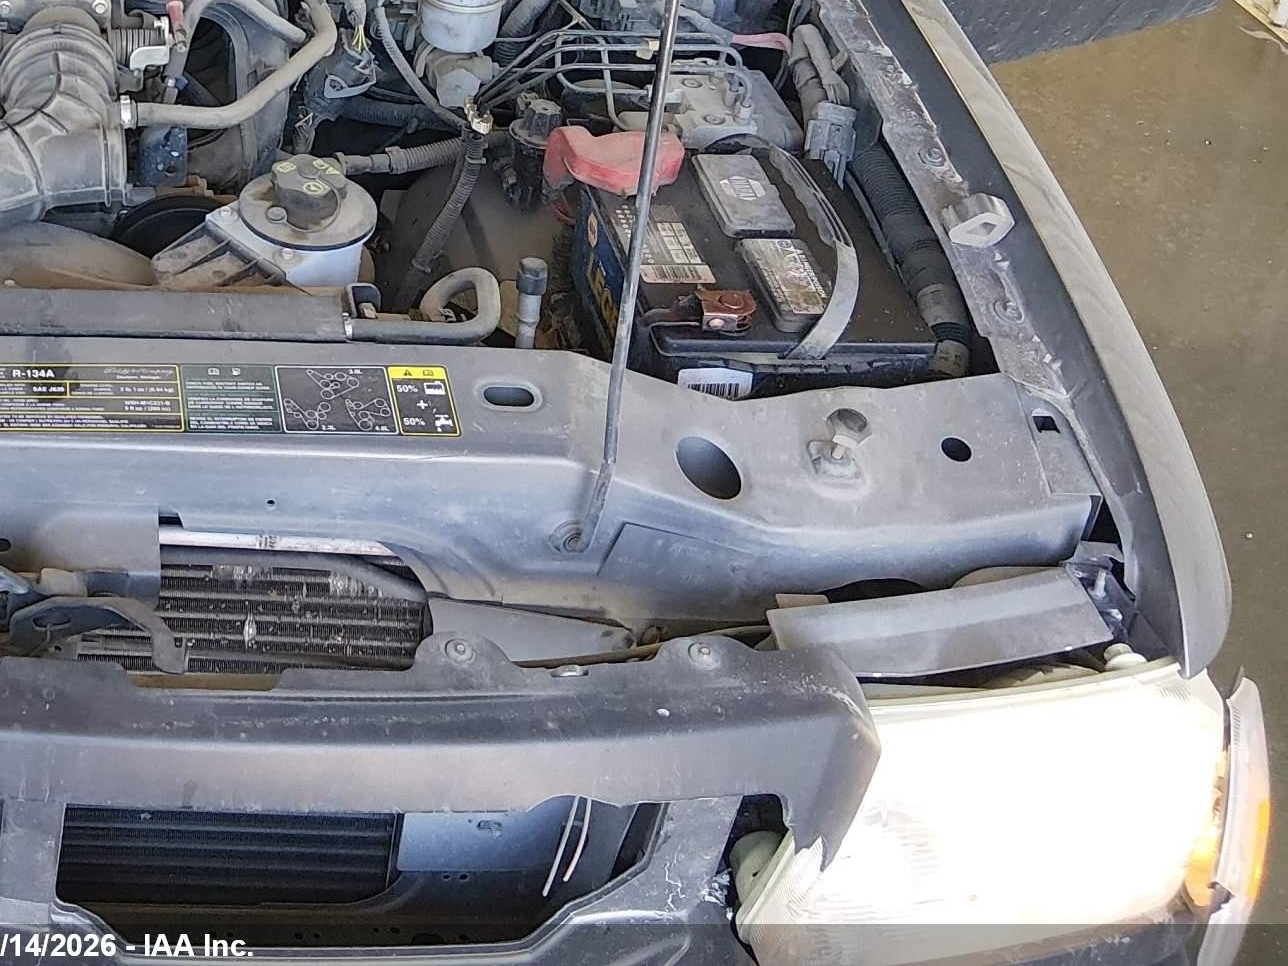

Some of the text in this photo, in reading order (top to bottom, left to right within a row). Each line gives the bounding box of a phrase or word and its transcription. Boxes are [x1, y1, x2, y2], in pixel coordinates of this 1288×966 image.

[12, 369, 55, 378] R-134A
[396, 384, 419, 393] 50%
[403, 418, 426, 426] 50%
